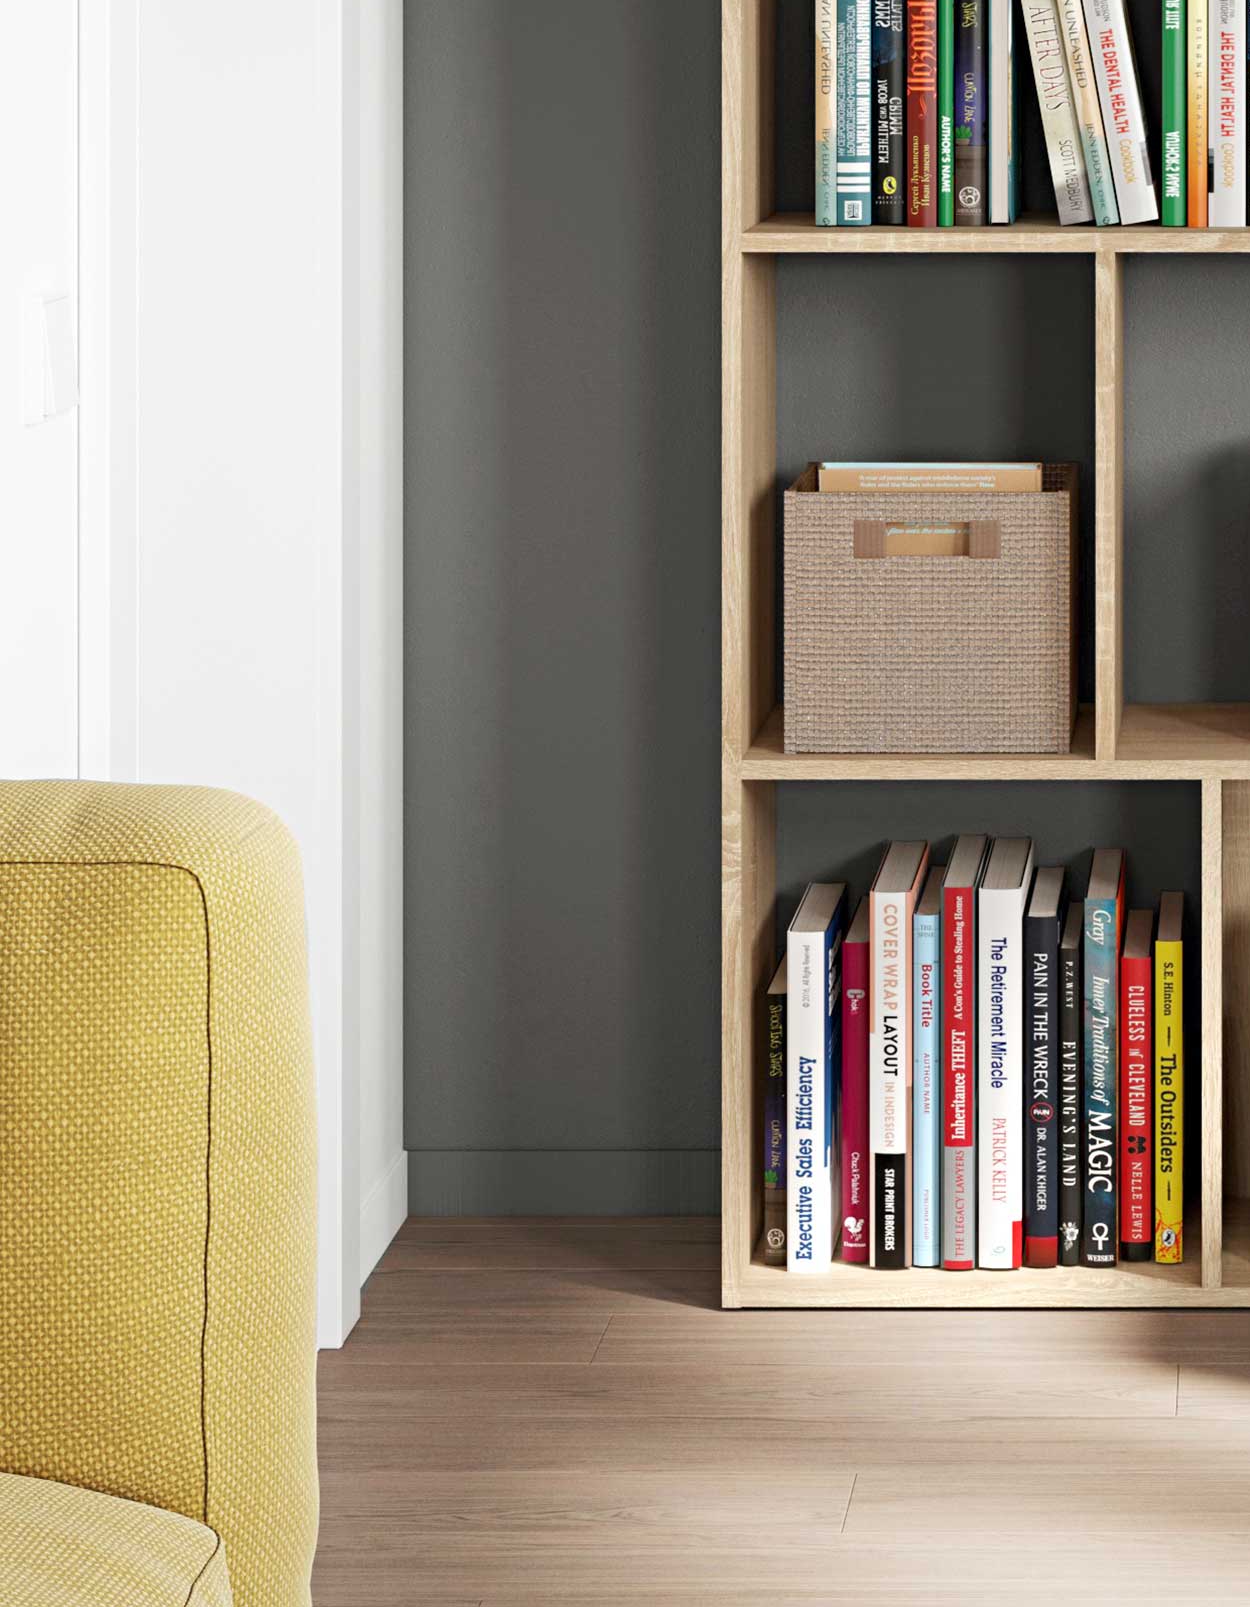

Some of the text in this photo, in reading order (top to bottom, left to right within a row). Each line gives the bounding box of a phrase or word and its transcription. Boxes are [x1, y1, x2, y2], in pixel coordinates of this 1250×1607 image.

[1029, 6, 1070, 111] AFTER DAYS
[1064, 11, 1087, 88] UNLEASHED
[1099, 29, 1136, 184] THE DENTAL HEALTH Cookbook
[942, 116, 951, 192] AUTHOR'S NAME
[1058, 140, 1083, 211] SCOTT MEDBURY
[954, 896, 963, 917] Home
[954, 919, 963, 952] Stealing
[1087, 909, 1111, 944] Gray
[922, 964, 932, 1027] Book Title
[954, 965, 963, 987] Guide
[954, 989, 963, 1011] Con's
[991, 938, 1007, 1088] The Retirement Miracle
[1128, 985, 1144, 1040] CLUELESS
[1163, 962, 1174, 1015] S.E. Hinton
[884, 904, 897, 1147] COVER WRAP LAYOUT IN INDESIGN
[1034, 953, 1047, 1098] PAIN IN THE WRECK
[952, 1029, 966, 1139] Inheritance THEFT
[1063, 1041, 1076, 1186] EVENING'S LAND
[1088, 976, 1112, 1192] Inner Traditions of MAGIC
[1129, 1063, 1145, 1125] CLEVELAND
[1161, 1054, 1176, 1173] The Outsiders
[796, 1056, 816, 1259] Executive Sales Efficiency
[851, 1152, 861, 1204] Chuck Palahniuk
[993, 1117, 1006, 1202] PATRICK KELLY
[1036, 1127, 1046, 1210] DR. ALAN KHIGER
[885, 1168, 895, 1250] STAR PRINT BROKERS
[955, 1150, 965, 1257] THE LEGACY LAWYERS
[1132, 1162, 1142, 1238] NELLE LEWIS
